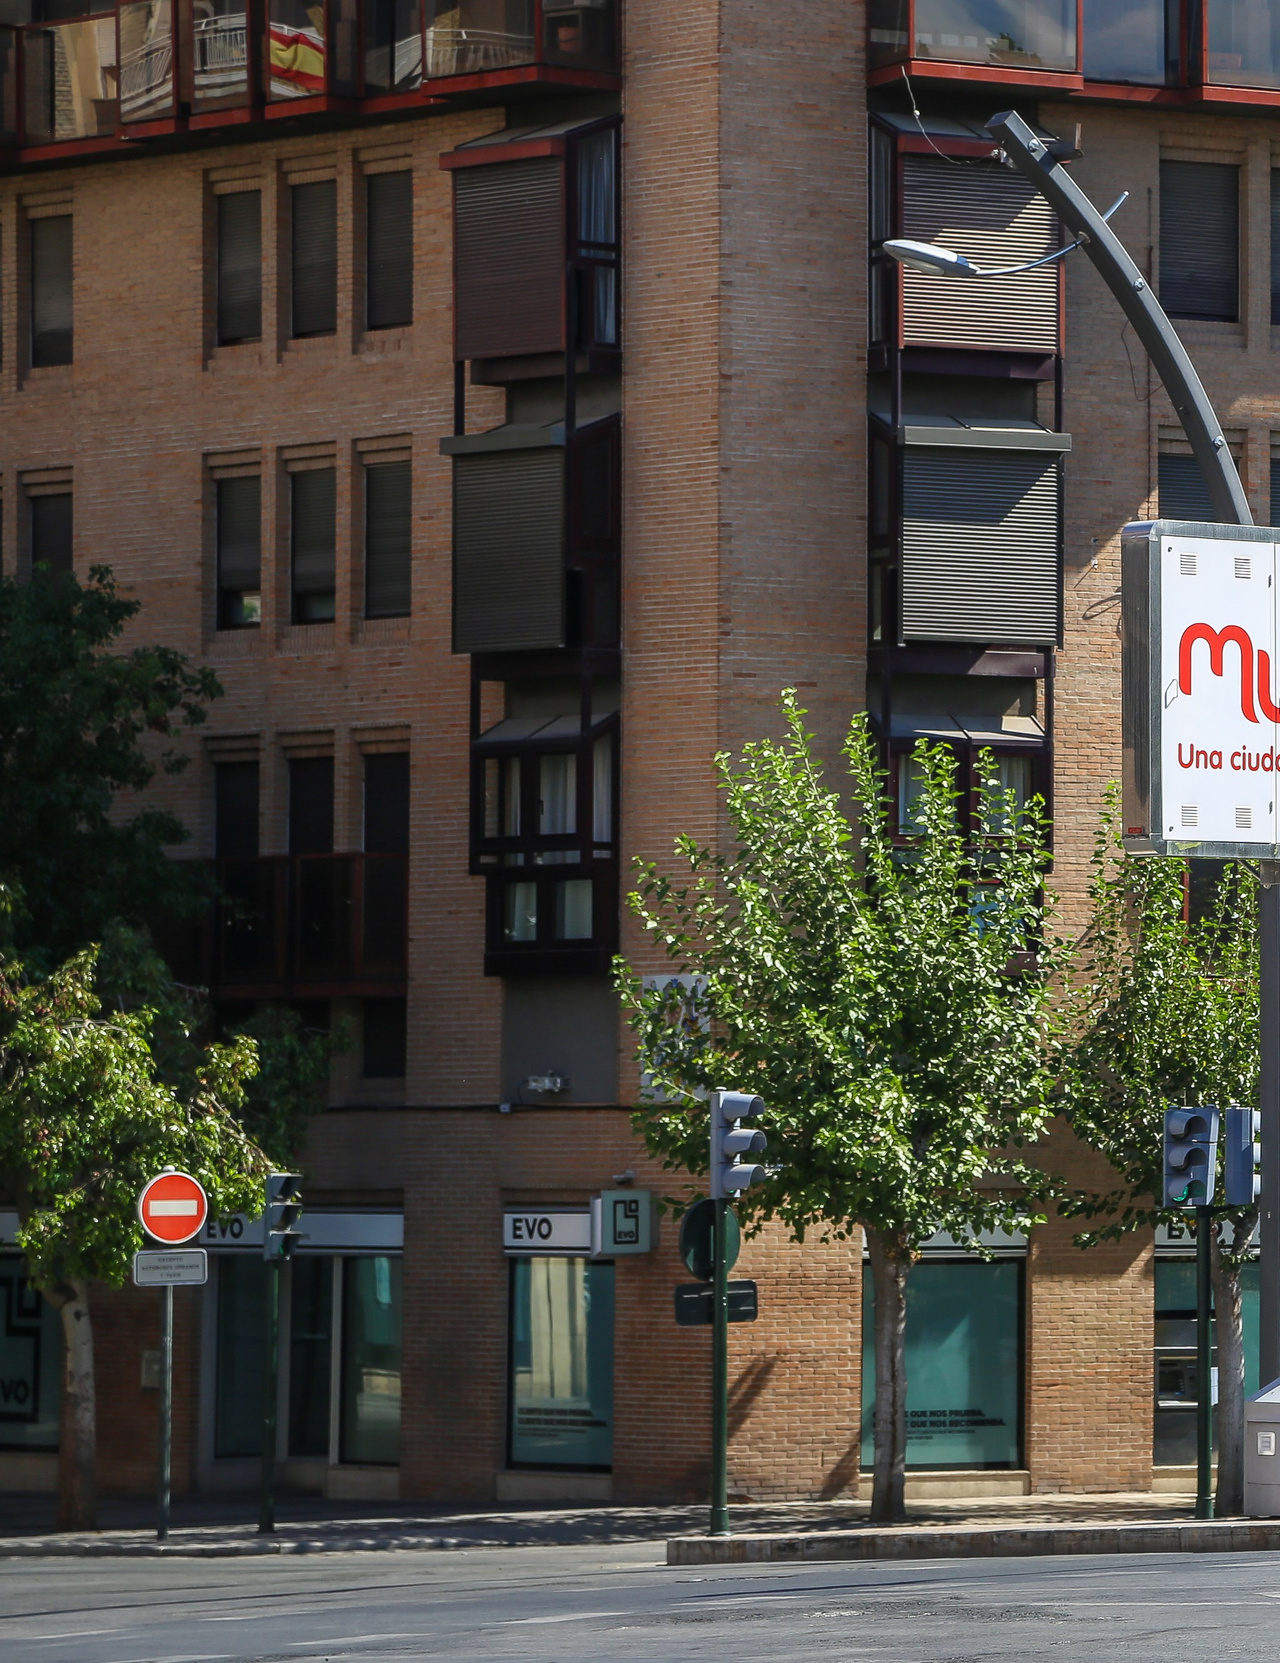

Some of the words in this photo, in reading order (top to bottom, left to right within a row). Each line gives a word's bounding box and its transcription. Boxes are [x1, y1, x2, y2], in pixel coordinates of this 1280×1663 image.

[1177, 743, 1223, 770] Una
[207, 1217, 244, 1240] EVO
[512, 1217, 552, 1240] EVO
[617, 1230, 635, 1240] EVO
[910, 1410, 928, 1418] QUE
[929, 1410, 948, 1418] NOS
[910, 1420, 928, 1428] QUE
[929, 1420, 948, 1428] NOS
